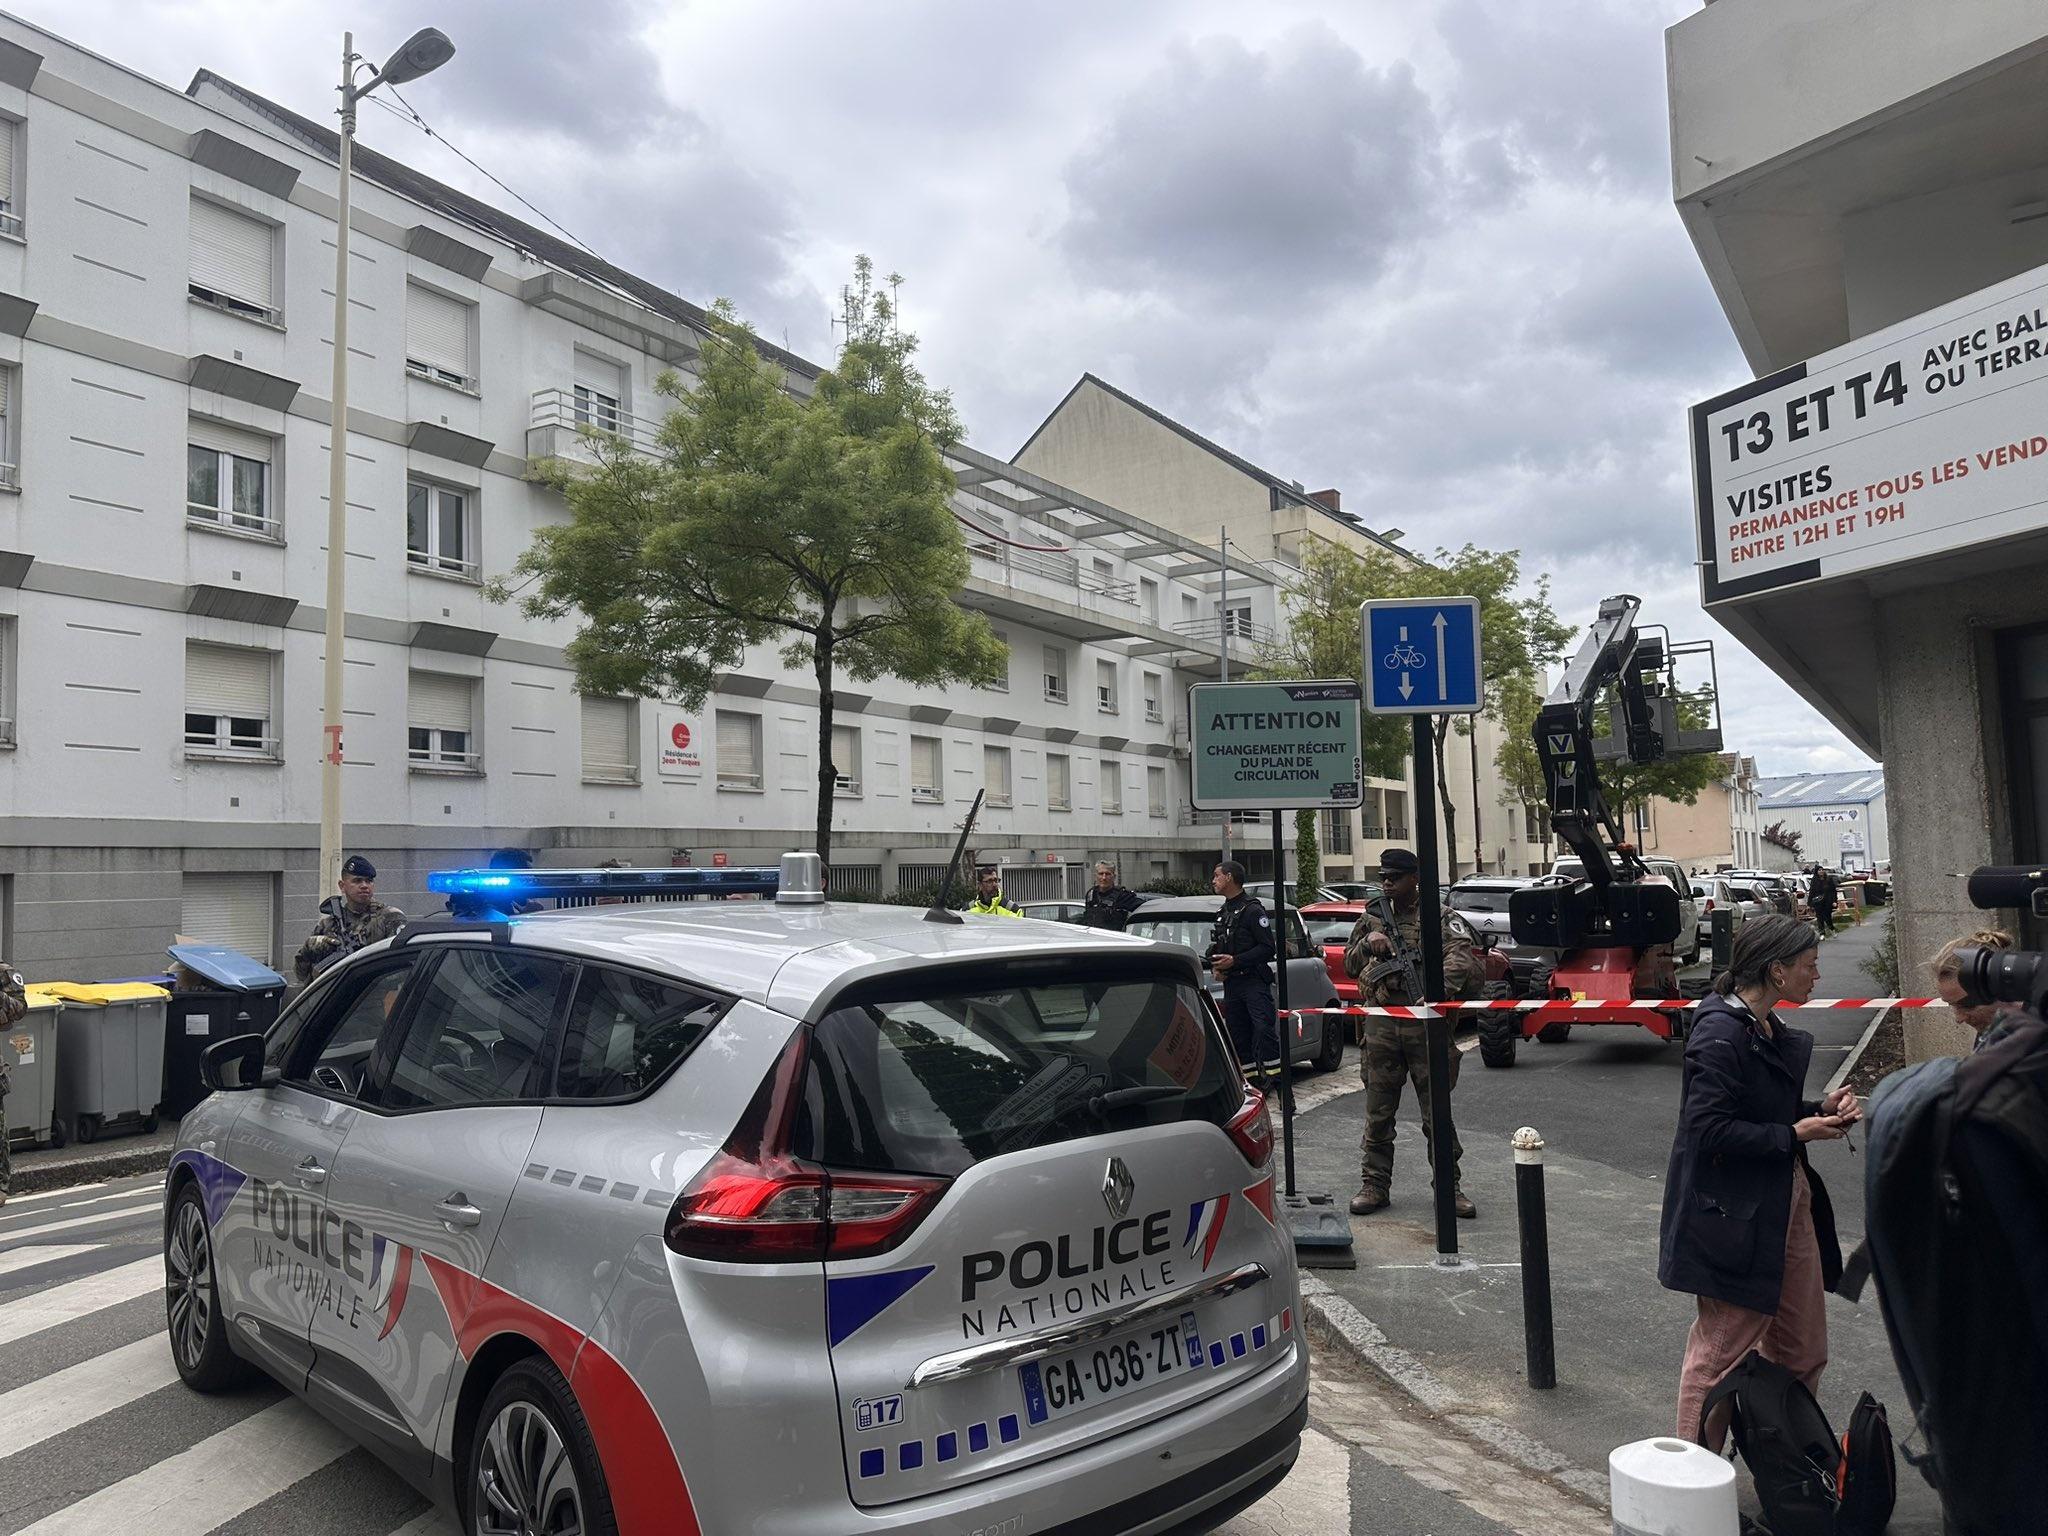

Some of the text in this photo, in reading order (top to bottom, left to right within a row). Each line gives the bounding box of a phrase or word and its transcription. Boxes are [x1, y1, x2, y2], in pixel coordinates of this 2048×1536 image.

[1922, 309, 2048, 371] AVEC BAL
[1925, 338, 2048, 394] OU TERR
[1721, 360, 1908, 462] T3 ET T4
[1726, 465, 1832, 517] VISITES
[1729, 436, 2048, 541] PERMANENCE TOUS LES VEND
[1731, 501, 1905, 564] ENTRE 12H ET 19H
[1207, 741, 1346, 756] CHANGEMENT RÉCENT
[1211, 711, 1341, 731] ATTENTION
[1234, 769, 1319, 782] CIRCULATION
[1240, 756, 1313, 768] DU PLAN DE
[253, 1177, 364, 1283] POLICE
[961, 1210, 1171, 1302] POLICE
[253, 1237, 363, 1329] NATIONALE
[961, 1260, 1175, 1339] NATIONALE
[1033, 1325, 1202, 1412] F GA-036-ZT 44
[873, 1397, 900, 1423] 17
